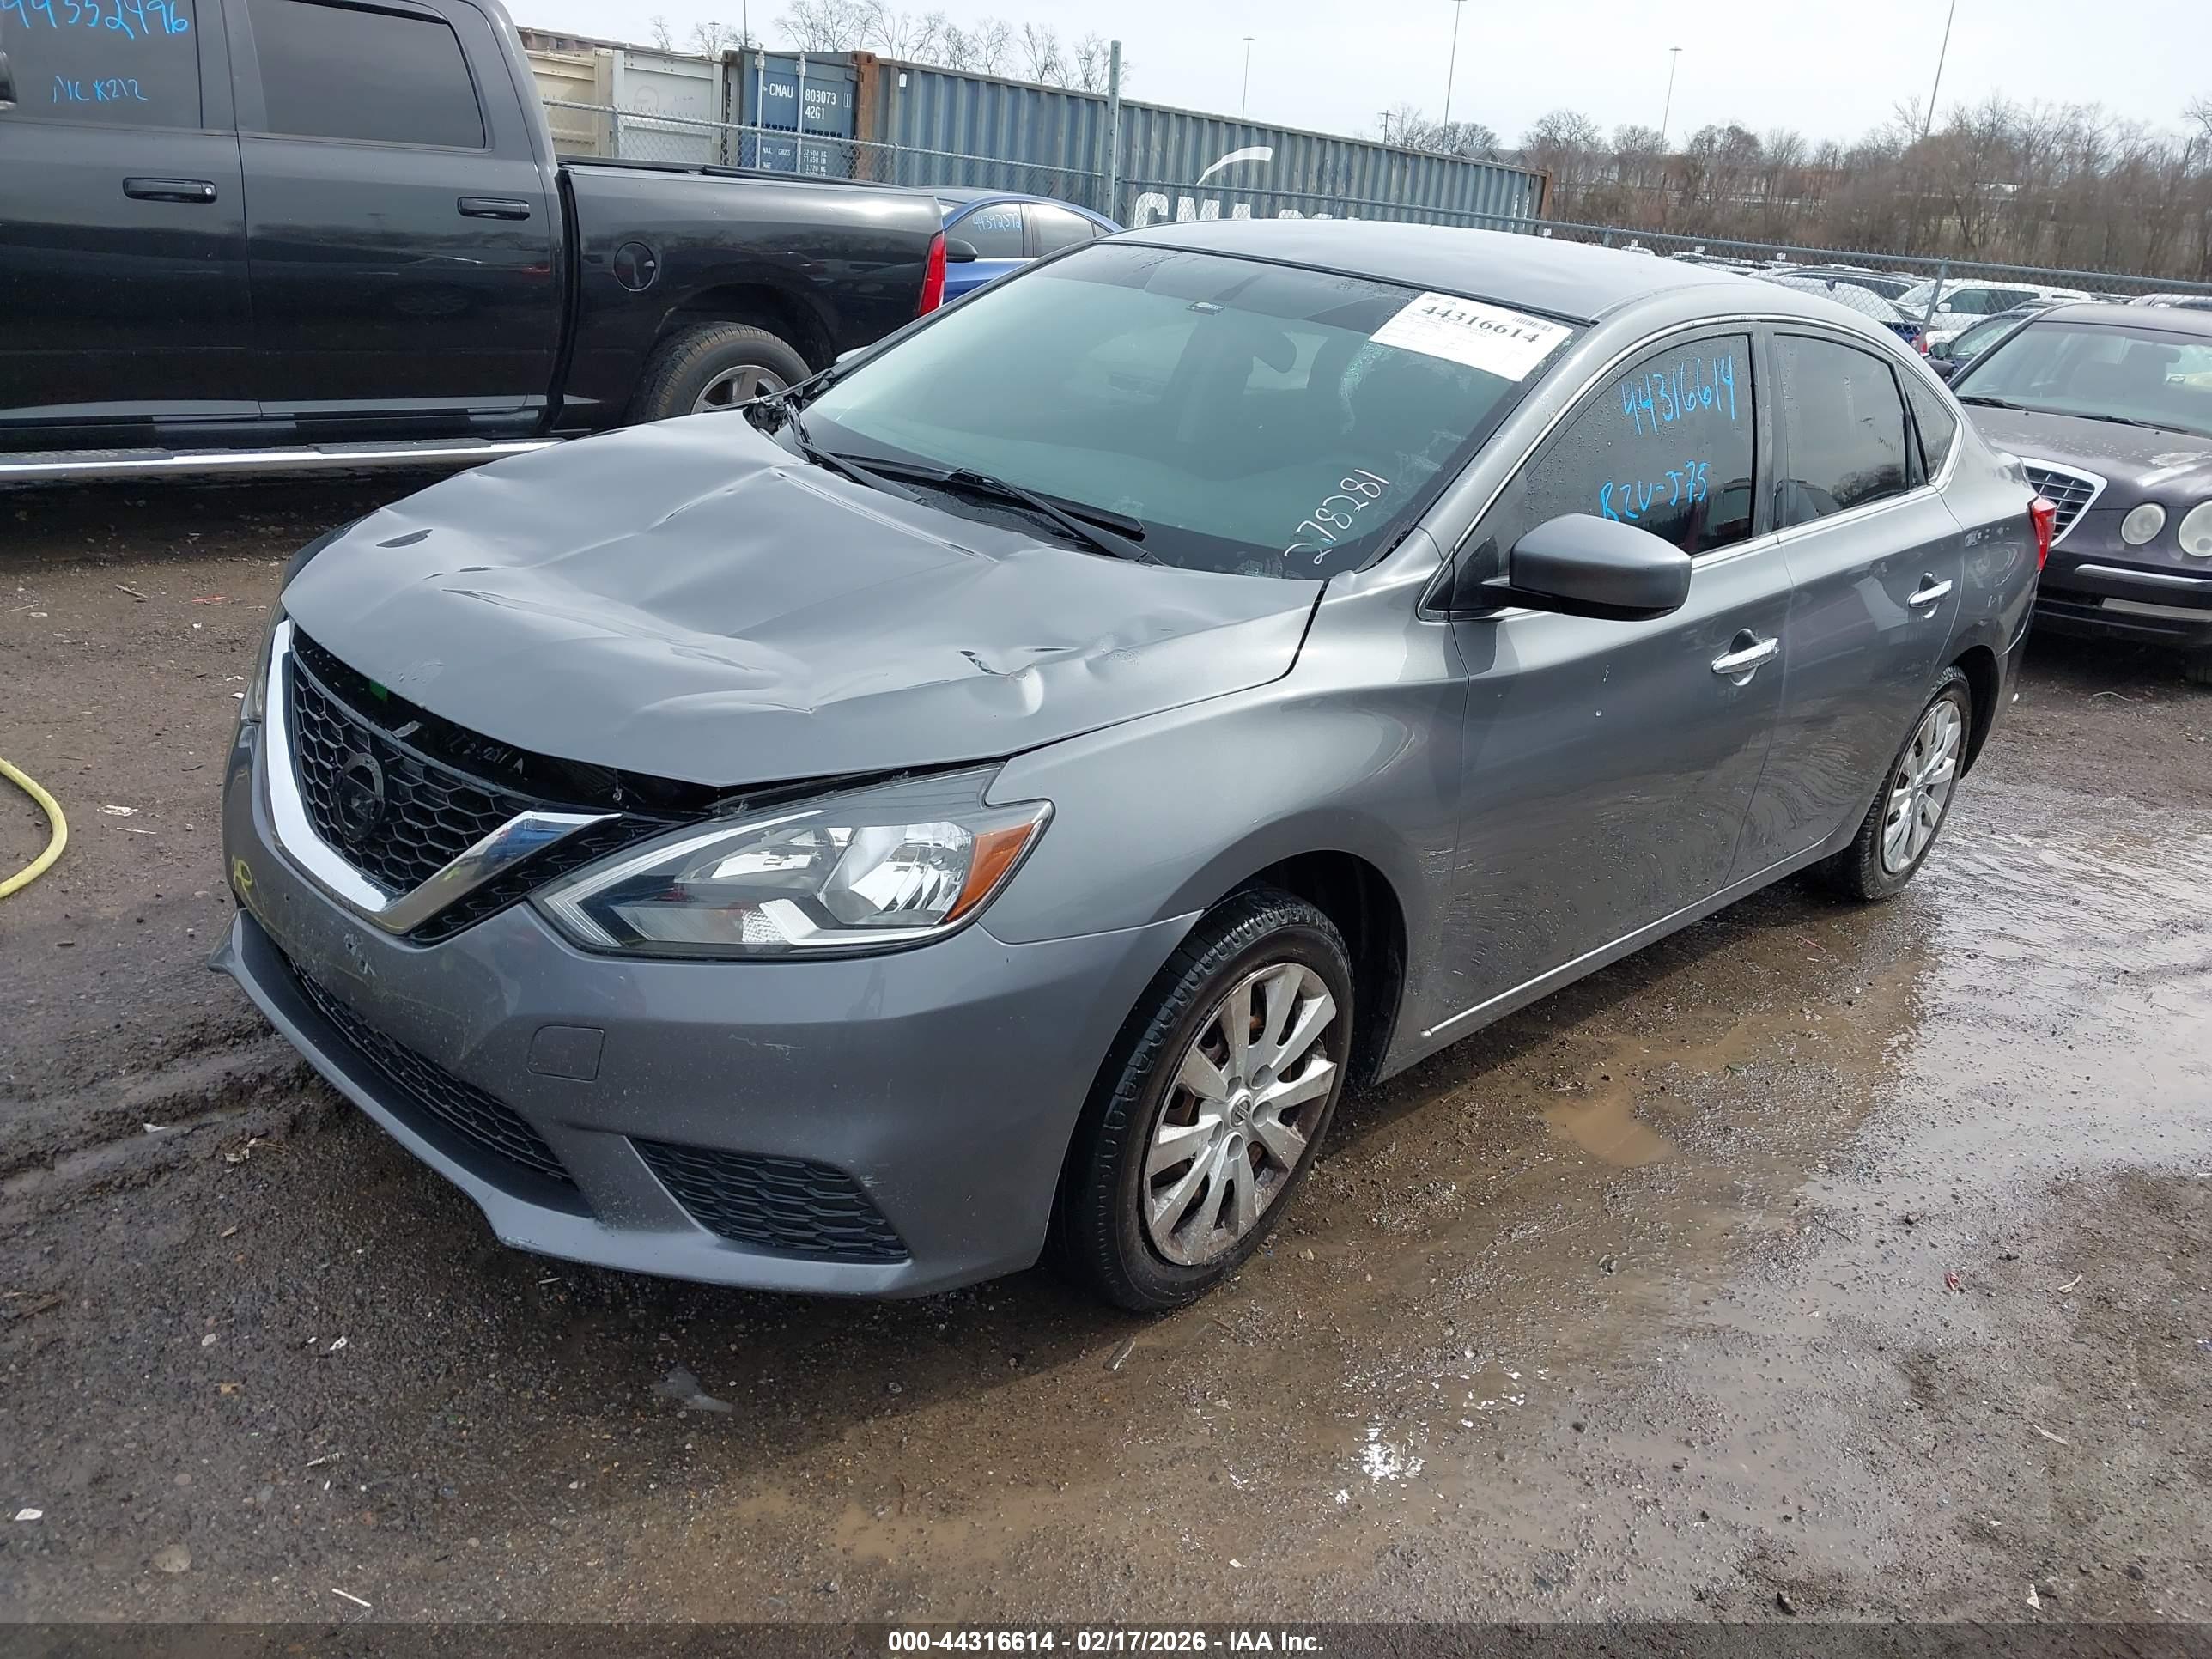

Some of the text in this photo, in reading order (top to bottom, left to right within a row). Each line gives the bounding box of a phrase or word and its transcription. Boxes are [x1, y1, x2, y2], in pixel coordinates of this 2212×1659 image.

[769, 83, 793, 98] CMAU
[805, 88, 836, 105] 803073
[805, 106, 825, 120] 42G1
[1421, 306, 1540, 343] 44316614
[1621, 355, 1735, 434] 44316614
[1284, 469, 1389, 564] 278281
